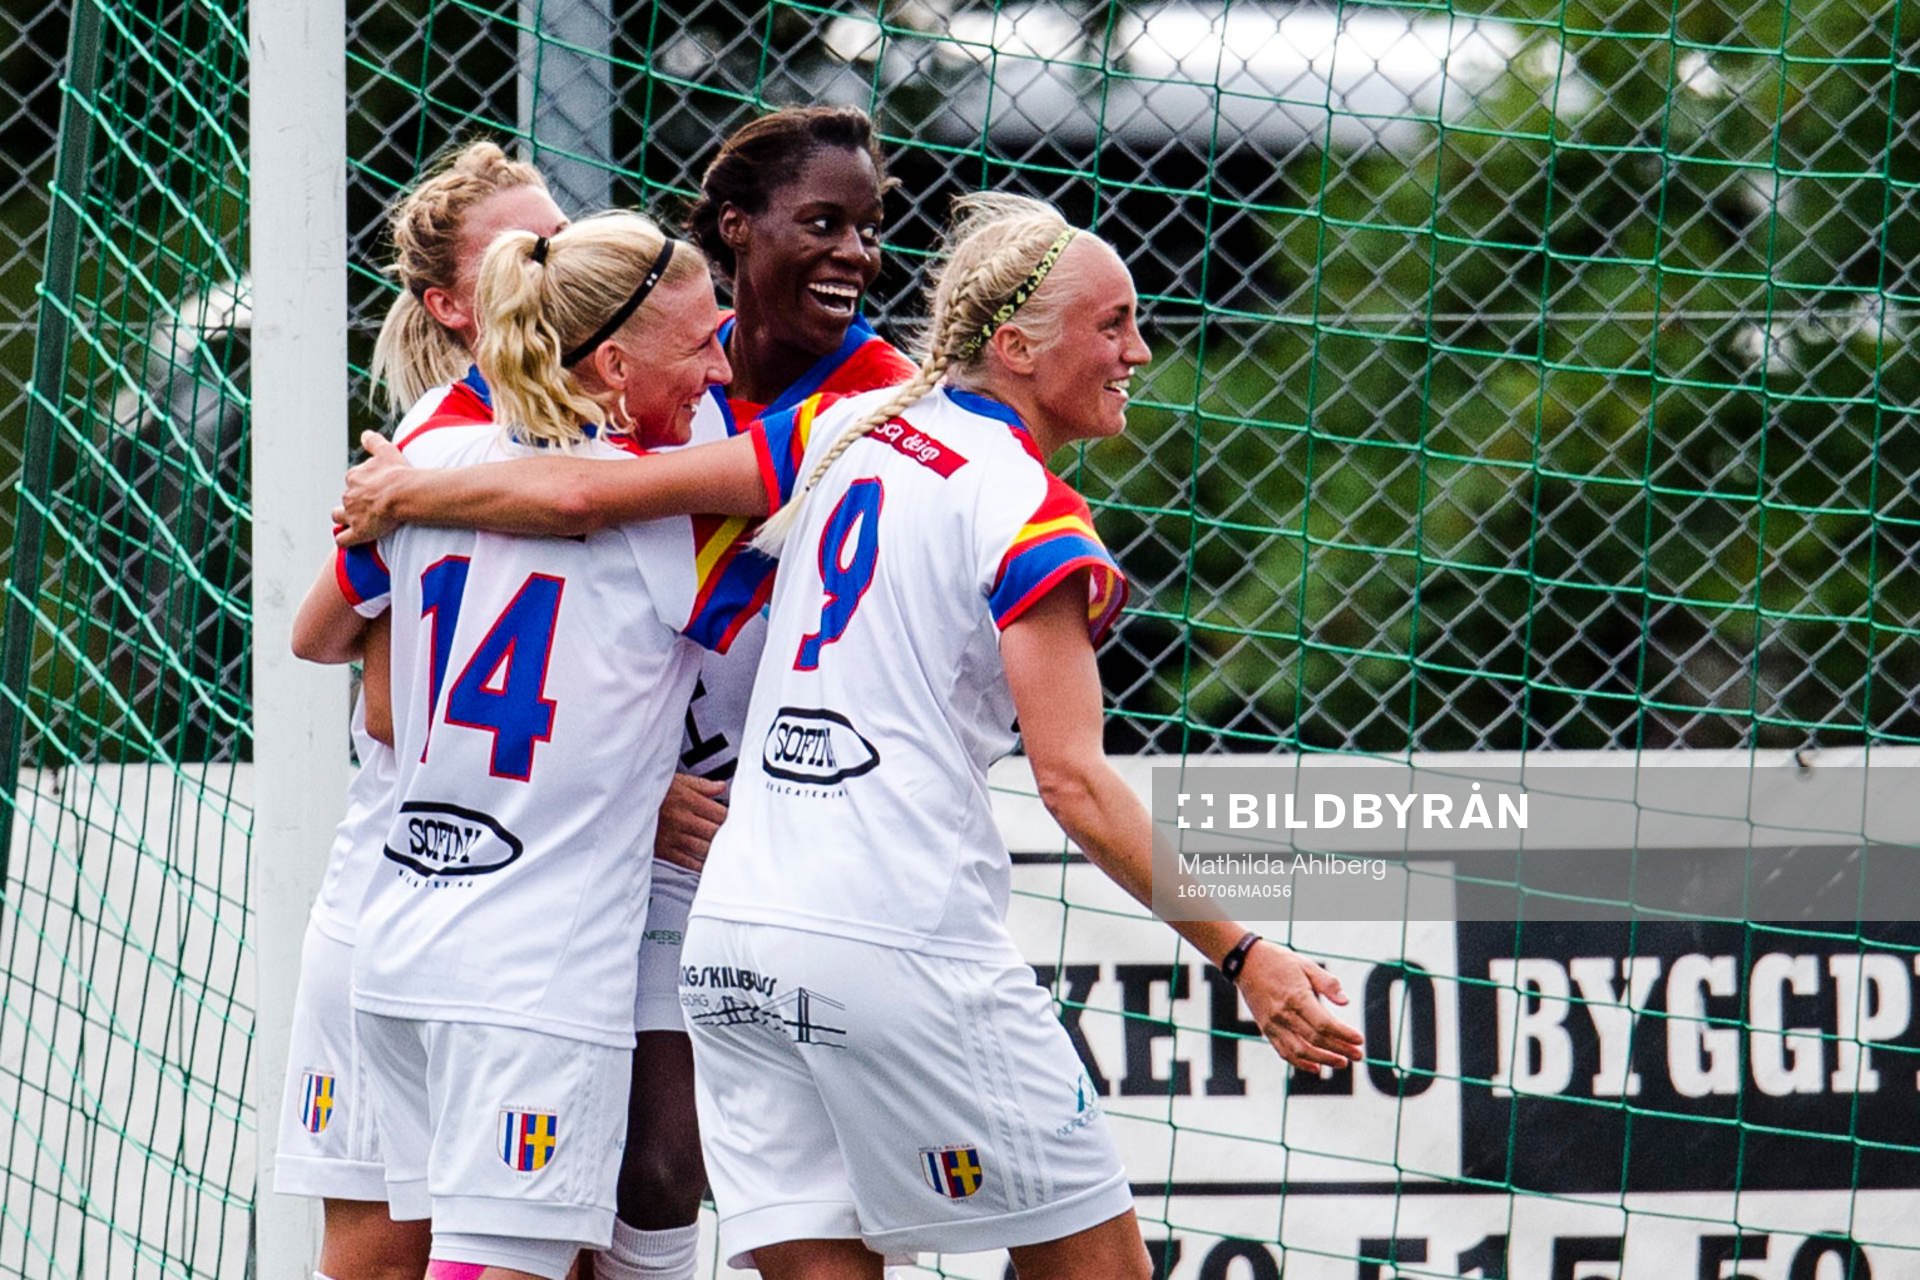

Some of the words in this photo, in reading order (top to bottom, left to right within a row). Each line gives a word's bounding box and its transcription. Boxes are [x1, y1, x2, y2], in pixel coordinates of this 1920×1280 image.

[420, 554, 566, 783] 14
[792, 475, 885, 671] 9
[1489, 952, 1920, 1099] BYGGP
